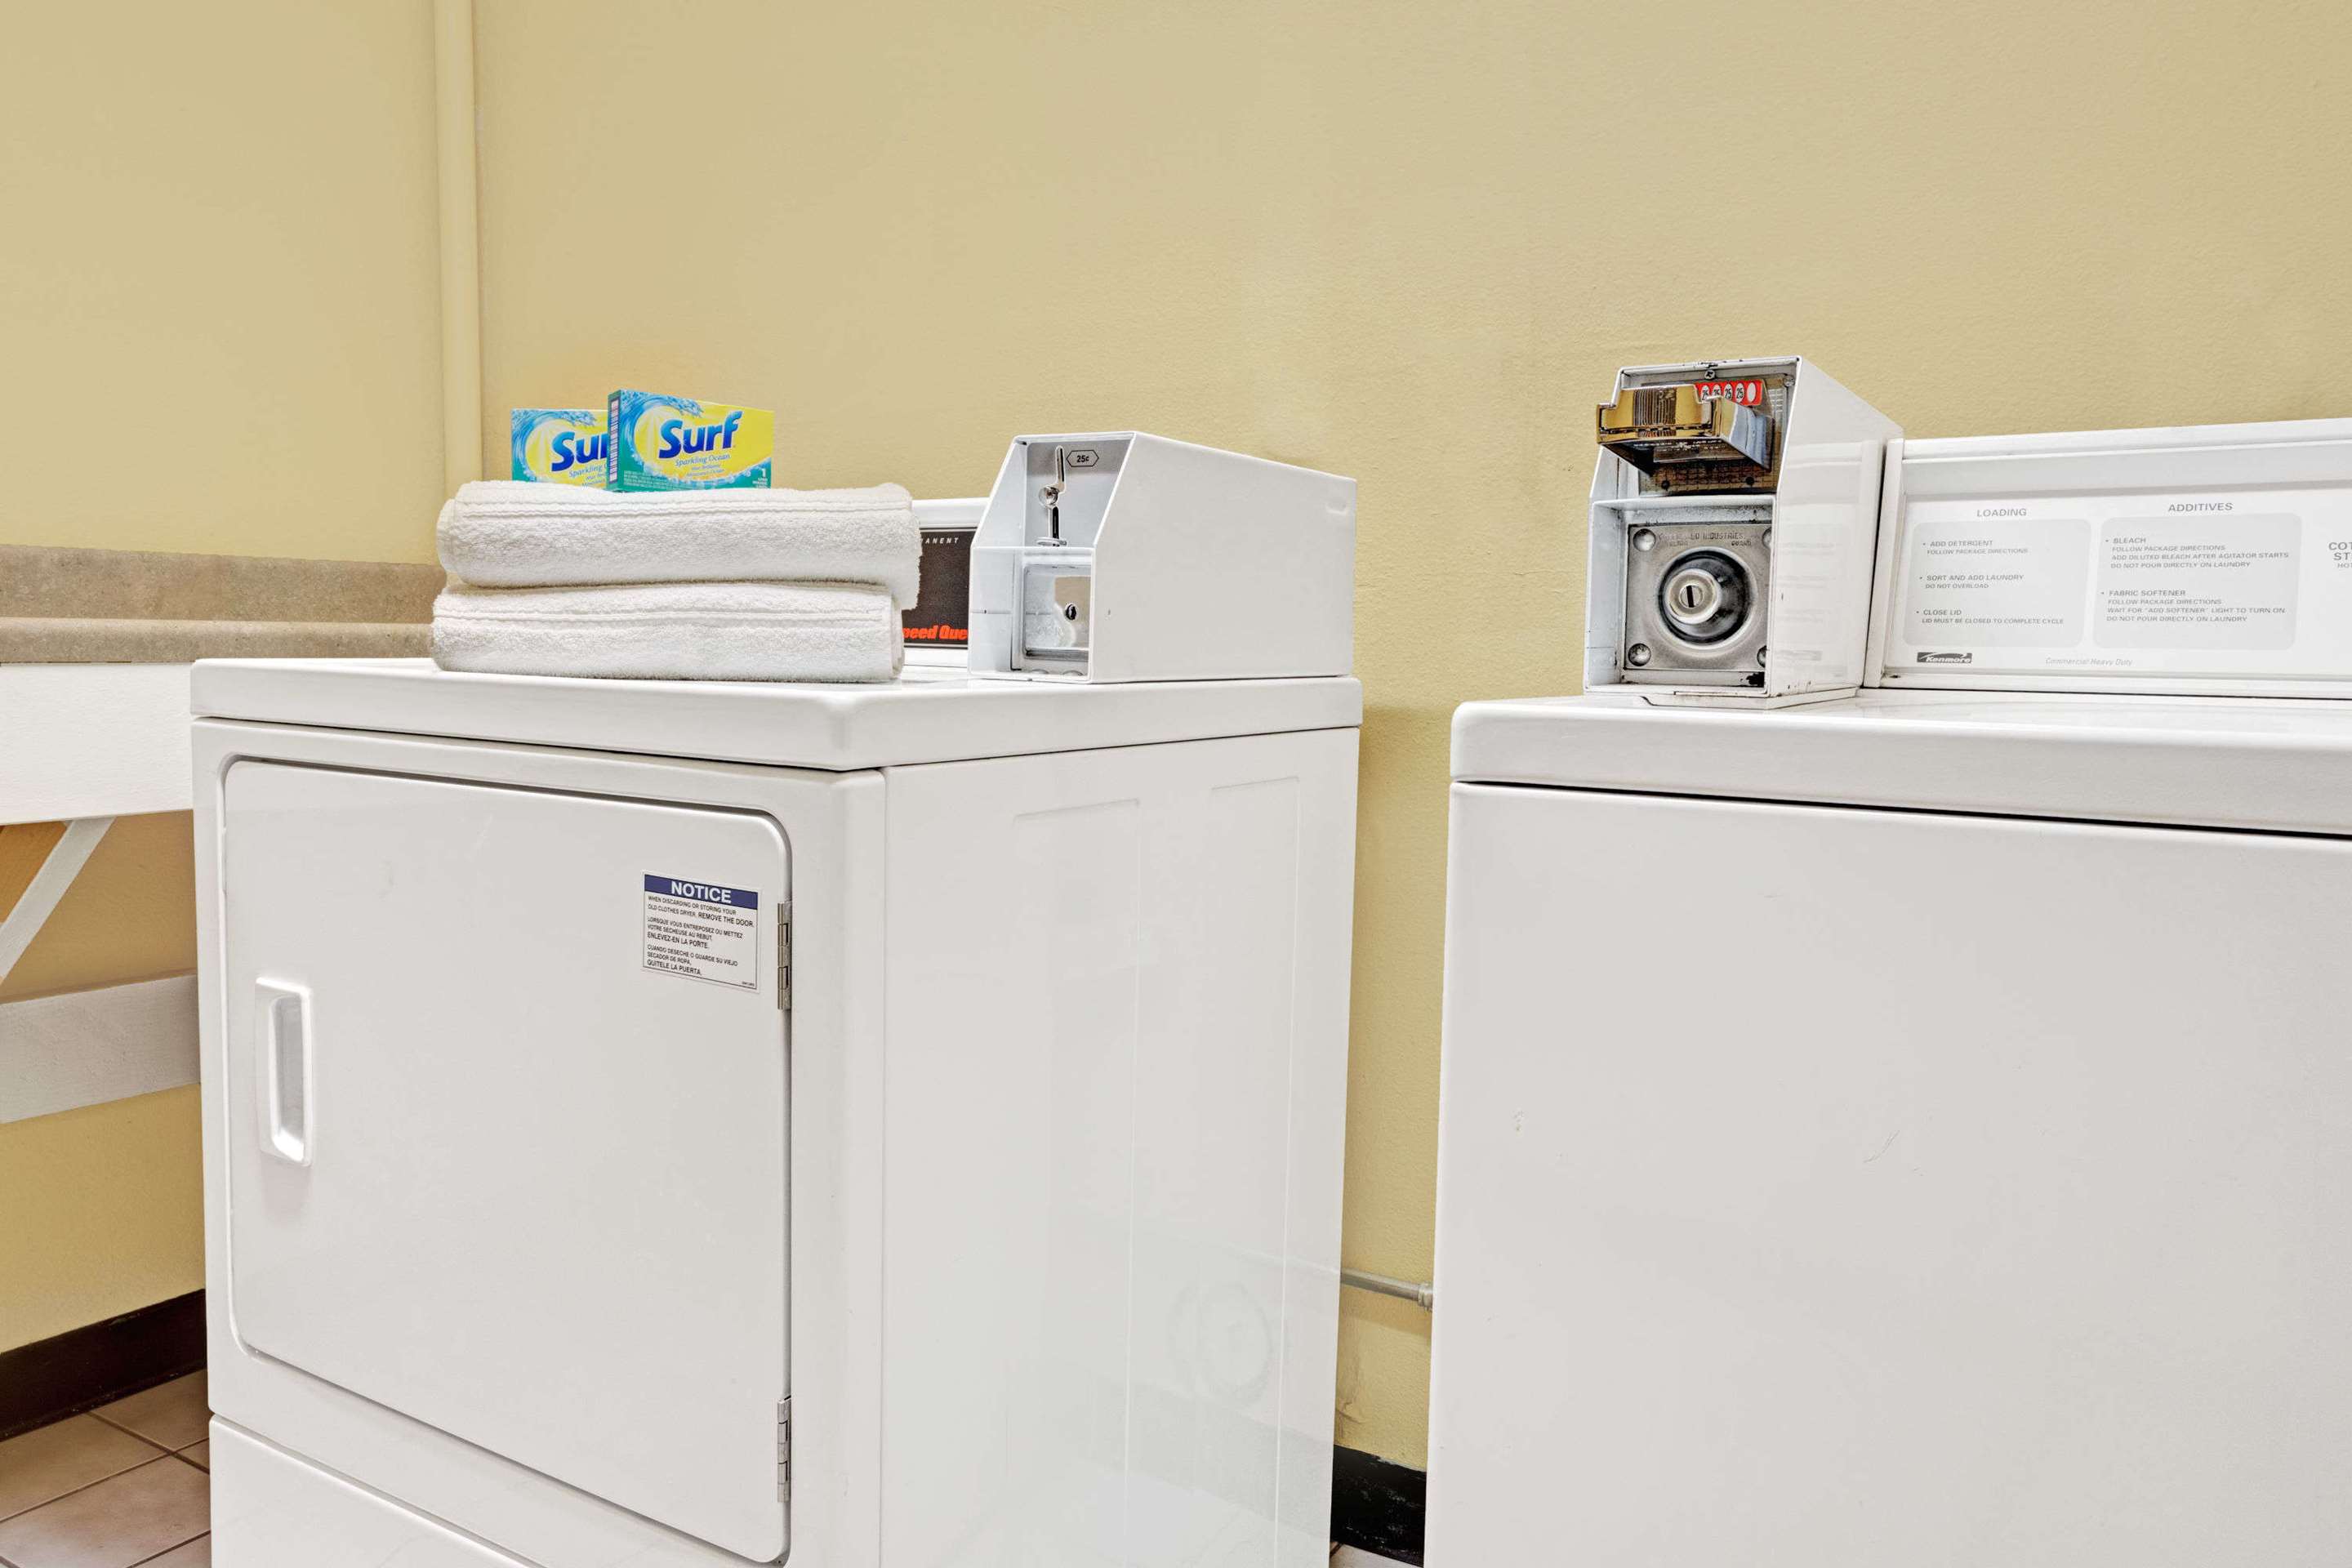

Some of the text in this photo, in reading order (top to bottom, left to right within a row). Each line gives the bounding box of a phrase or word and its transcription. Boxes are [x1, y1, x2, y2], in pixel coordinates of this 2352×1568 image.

[1725, 389, 1731, 399] 25
[1736, 388, 1743, 399] 25
[659, 411, 743, 459] Surf
[675, 455, 706, 467] Sparkling
[708, 453, 731, 462] Ocean
[569, 464, 603, 478] Sparkling
[761, 468, 766, 477] 1
[1976, 508, 2027, 517] LOADING
[2168, 502, 2233, 512] ADDITIVES
[1926, 655, 1972, 663] Kenmore
[2091, 658, 2114, 666] Heavy
[2115, 658, 2133, 666] Duty
[671, 880, 732, 904] NOTICE
[648, 895, 662, 903] WHEN
[662, 898, 691, 908] DISCARDING
[700, 904, 721, 914] STORING
[658, 905, 679, 915] CLOTHES
[698, 912, 723, 922] REMOVE
[724, 916, 735, 924] THE
[736, 919, 755, 928] DOOR.
[648, 917, 669, 926] LORSQUE
[684, 923, 715, 934] ENTREPOSEZ
[724, 930, 744, 939] METTEZ
[648, 924, 662, 933] VOTRE
[648, 932, 679, 943] ENLEVEZ-EN
[689, 939, 710, 949] PORTE.
[648, 944, 667, 954] CUANDO
[667, 947, 689, 957] DESECHE
[695, 953, 715, 963] GUARDE
[724, 959, 738, 967] VIEJO
[648, 951, 669, 962] SECADOR
[648, 959, 670, 969] QUITELE
[679, 964, 702, 976] PUERTA.
